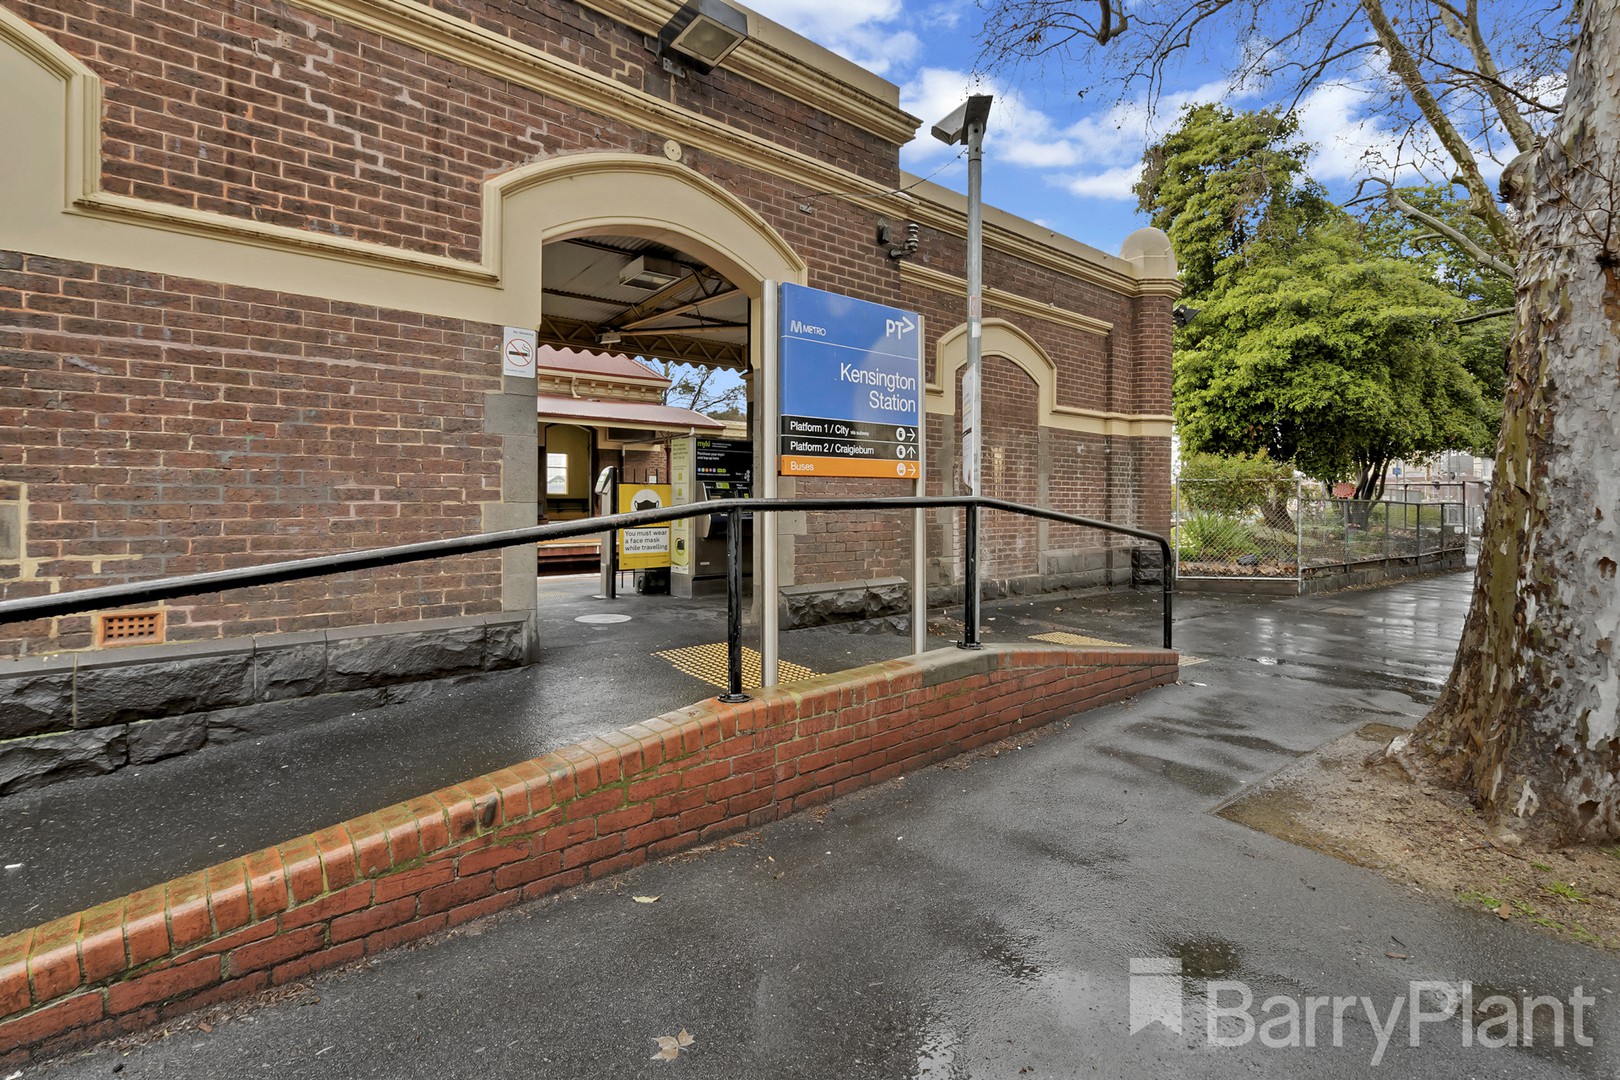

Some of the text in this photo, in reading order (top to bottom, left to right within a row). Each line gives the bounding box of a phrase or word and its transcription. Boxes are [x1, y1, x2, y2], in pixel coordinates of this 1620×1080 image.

[802, 326, 827, 336] METRO
[840, 362, 916, 392] Kensington
[869, 390, 916, 412] Station
[790, 420, 822, 433] Platform
[825, 424, 828, 434] 1
[834, 424, 850, 436] City
[790, 440, 822, 452] Platform
[824, 443, 829, 452] 2
[834, 444, 874, 456] Craigieburn
[790, 460, 814, 472] Buses
